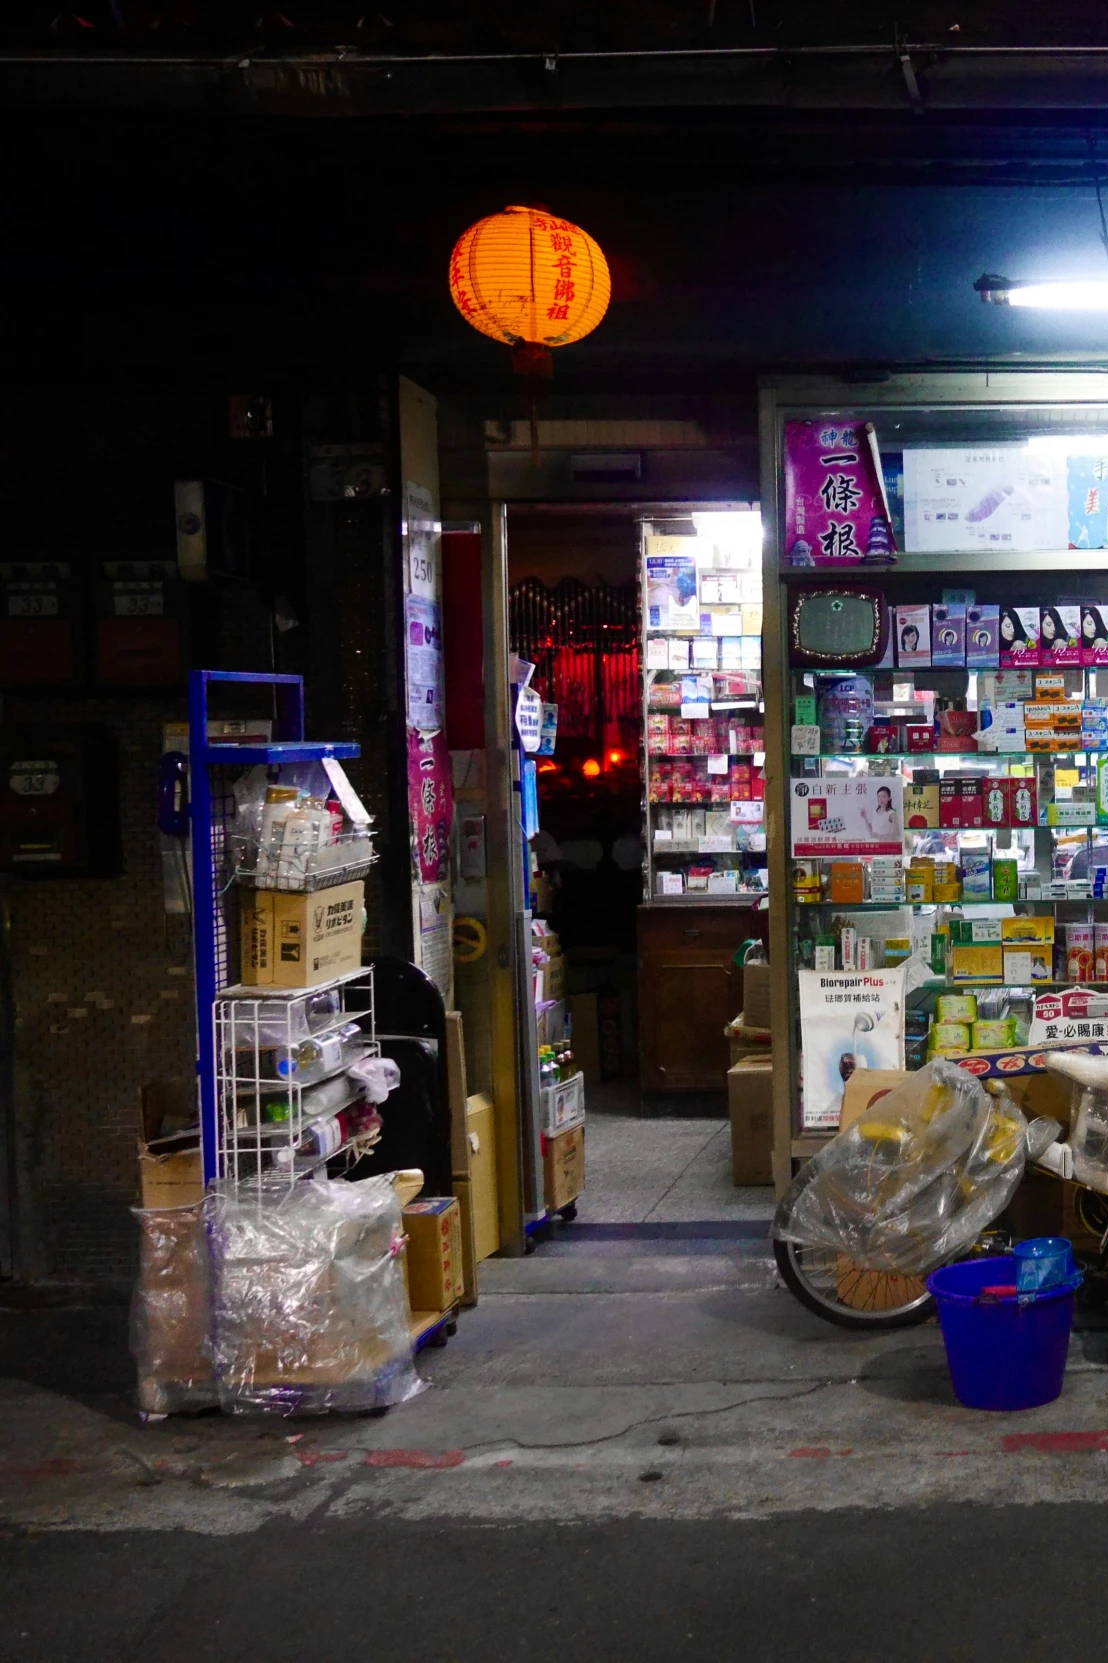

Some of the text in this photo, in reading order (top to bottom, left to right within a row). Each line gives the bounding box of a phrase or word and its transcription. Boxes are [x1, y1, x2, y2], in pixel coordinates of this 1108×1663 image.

[546, 232, 578, 321] 觀音佛祖
[821, 429, 857, 446] 神龍
[820, 454, 861, 556] 一條根
[413, 557, 433, 583] 250
[812, 783, 867, 796] 白新主張
[325, 912, 353, 930] リポビタン
[820, 976, 884, 989] Biorepair Plus
[1043, 1010, 1055, 1018] 50
[1045, 1023, 1104, 1039] 愛-必賜康
